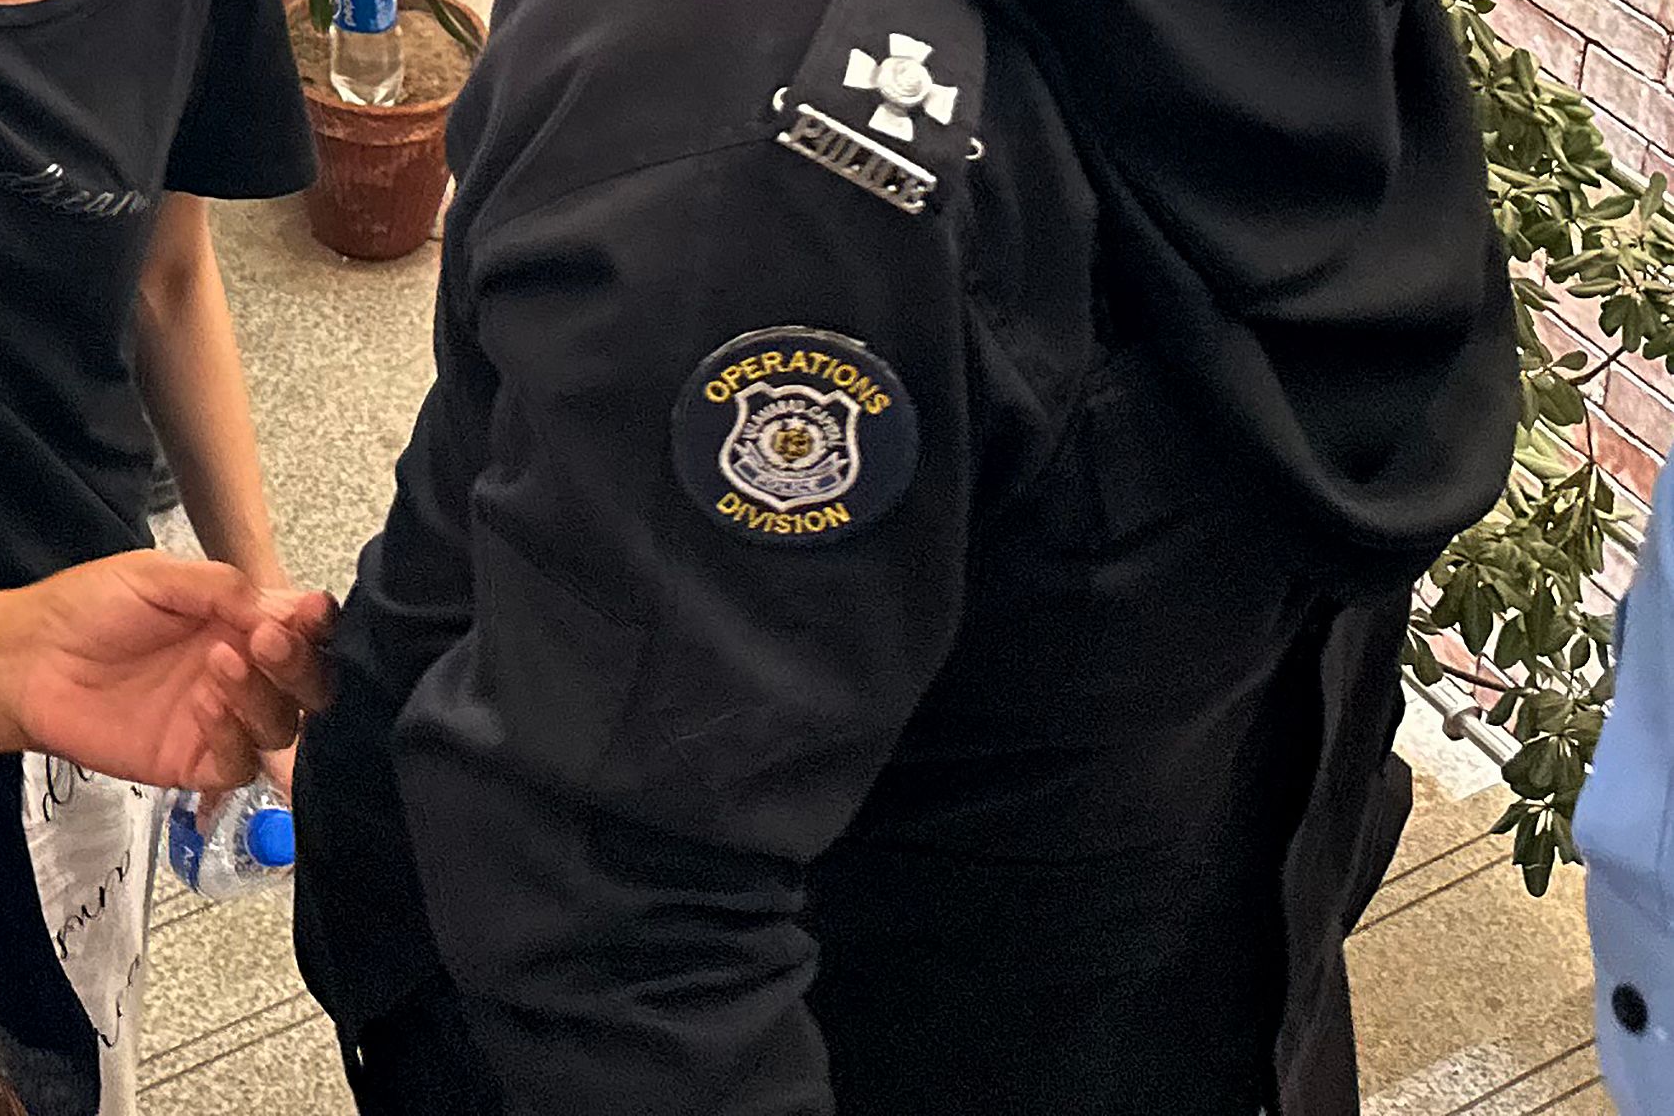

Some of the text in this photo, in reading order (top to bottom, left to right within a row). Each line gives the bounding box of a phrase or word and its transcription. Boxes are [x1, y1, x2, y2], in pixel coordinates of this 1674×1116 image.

[779, 108, 935, 214] POLICE
[705, 350, 892, 415] OPERATIONS
[716, 492, 851, 534] DIVISION
